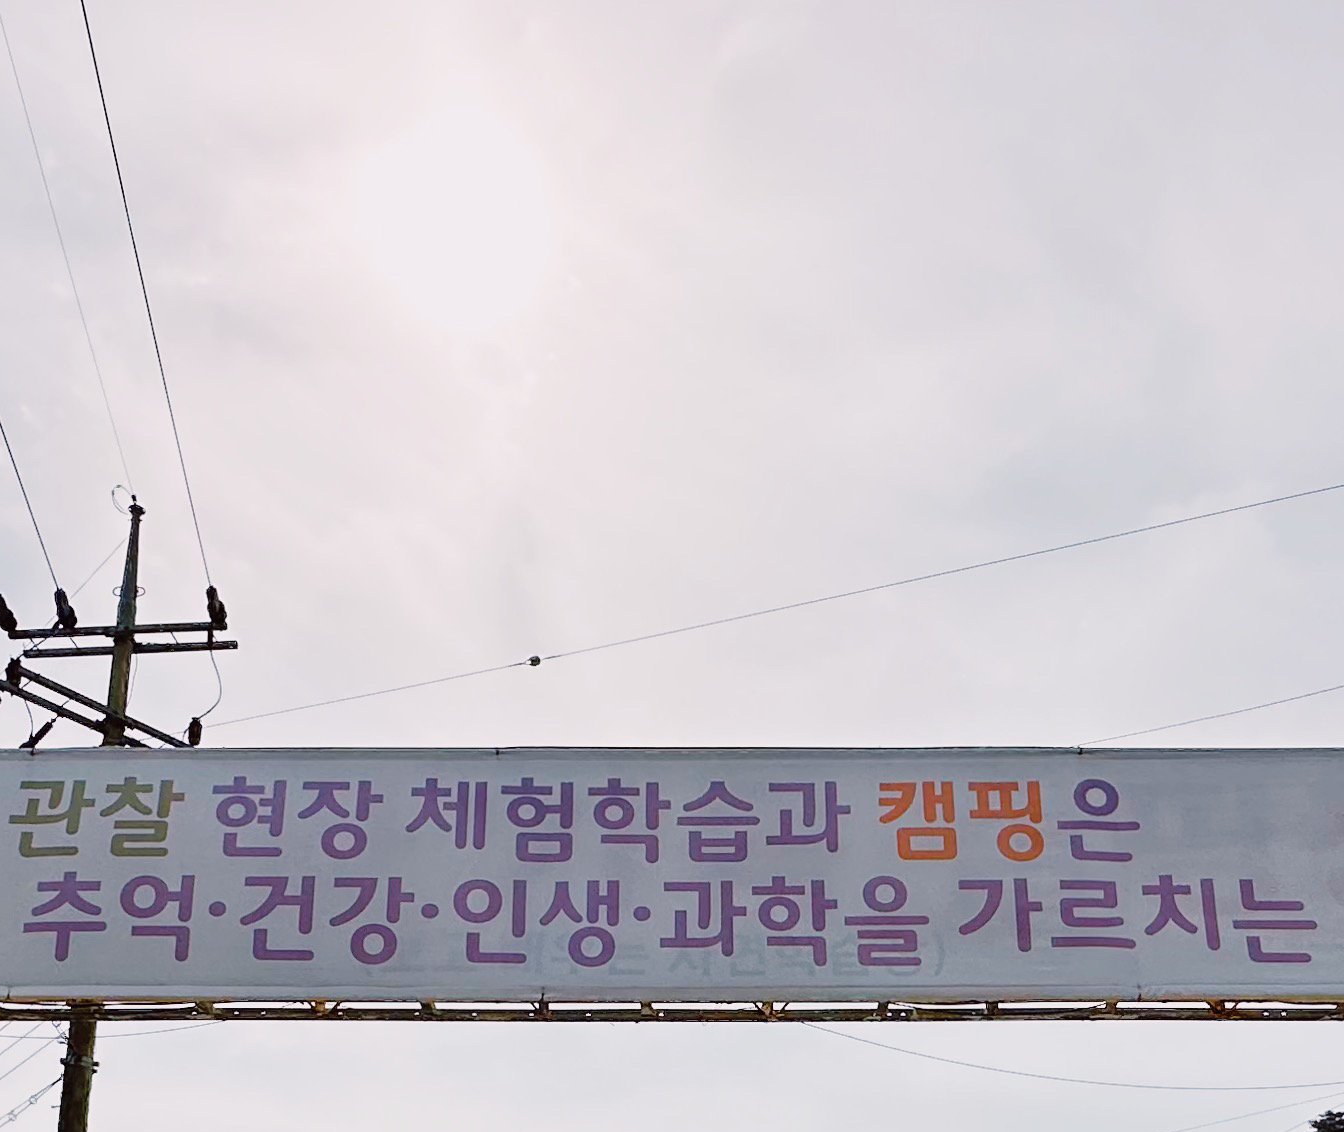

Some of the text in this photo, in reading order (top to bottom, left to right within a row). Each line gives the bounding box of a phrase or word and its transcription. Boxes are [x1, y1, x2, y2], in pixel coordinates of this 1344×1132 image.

[10, 781, 184, 857] 관찰
[213, 777, 383, 859] 현장
[407, 778, 850, 863] 체험학습과
[879, 780, 1140, 862] 캠핑은
[959, 875, 1317, 962] 가르치는
